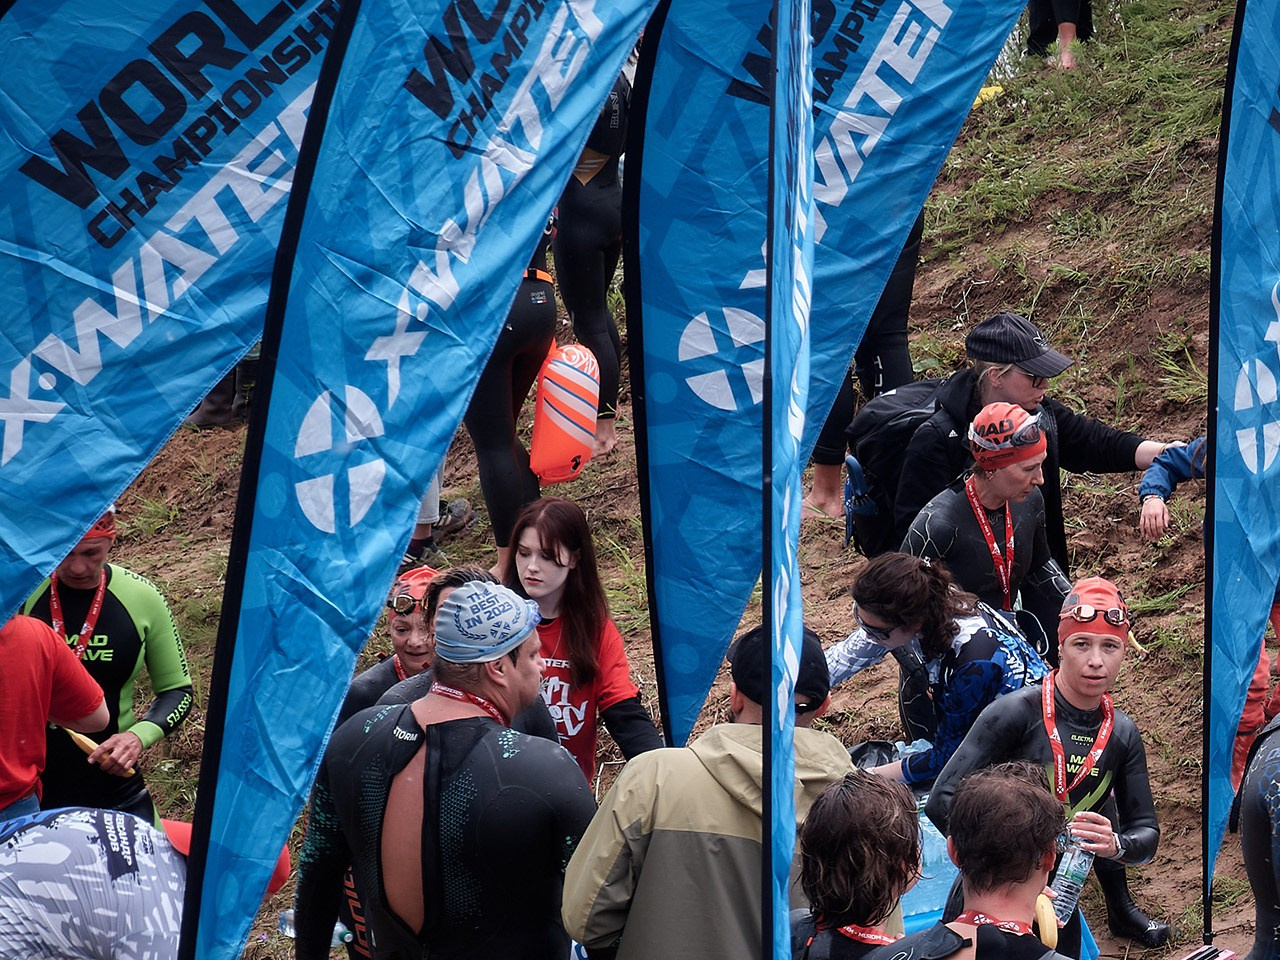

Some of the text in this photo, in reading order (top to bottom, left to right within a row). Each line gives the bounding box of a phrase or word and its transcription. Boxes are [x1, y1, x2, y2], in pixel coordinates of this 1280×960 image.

[19, 0, 304, 209] WORL
[87, 0, 342, 249] CHAMPIONSHI
[467, 588, 492, 602] THE
[470, 594, 500, 615] BEST
[464, 601, 513, 629] IN 2023
[1069, 754, 1087, 766] MA
[1066, 763, 1100, 777] WE
[857, 931, 881, 941] MUROM
